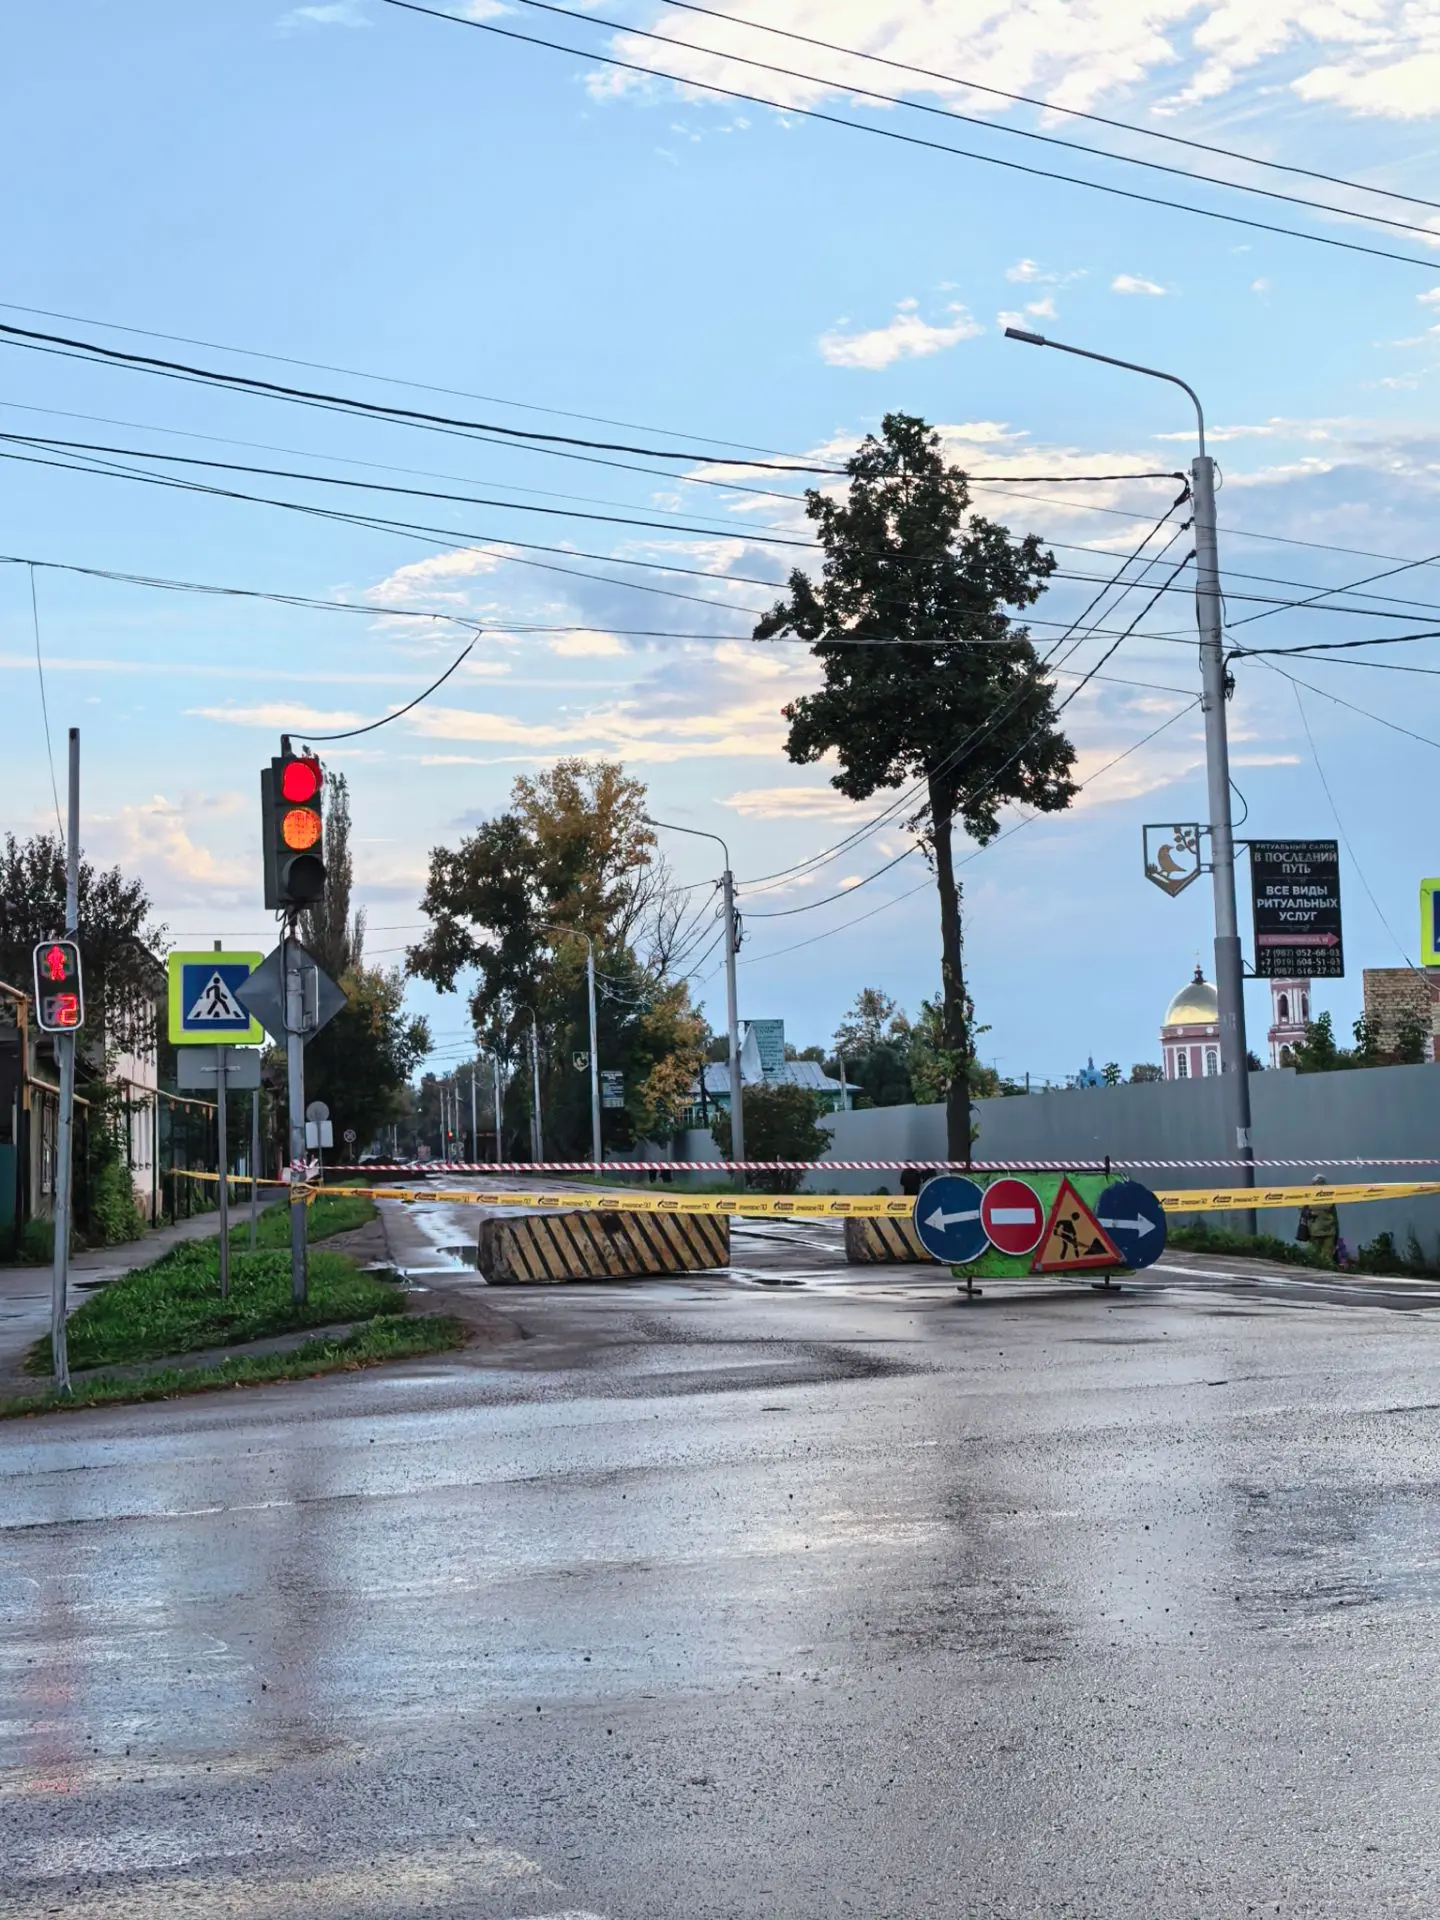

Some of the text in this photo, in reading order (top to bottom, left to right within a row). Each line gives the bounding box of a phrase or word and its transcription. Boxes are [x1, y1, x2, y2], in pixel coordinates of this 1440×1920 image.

[1254, 851, 1337, 862] В ПОСЛЕДНИЙ
[1282, 864, 1311, 874] ПУТЬ
[1266, 886, 1328, 896] ВСЕ ВИДЫ
[1257, 898, 1338, 909] РИТУАЛЬНЫХ
[1278, 911, 1318, 921] УСЛУГ
[57, 993, 77, 1025] 2
